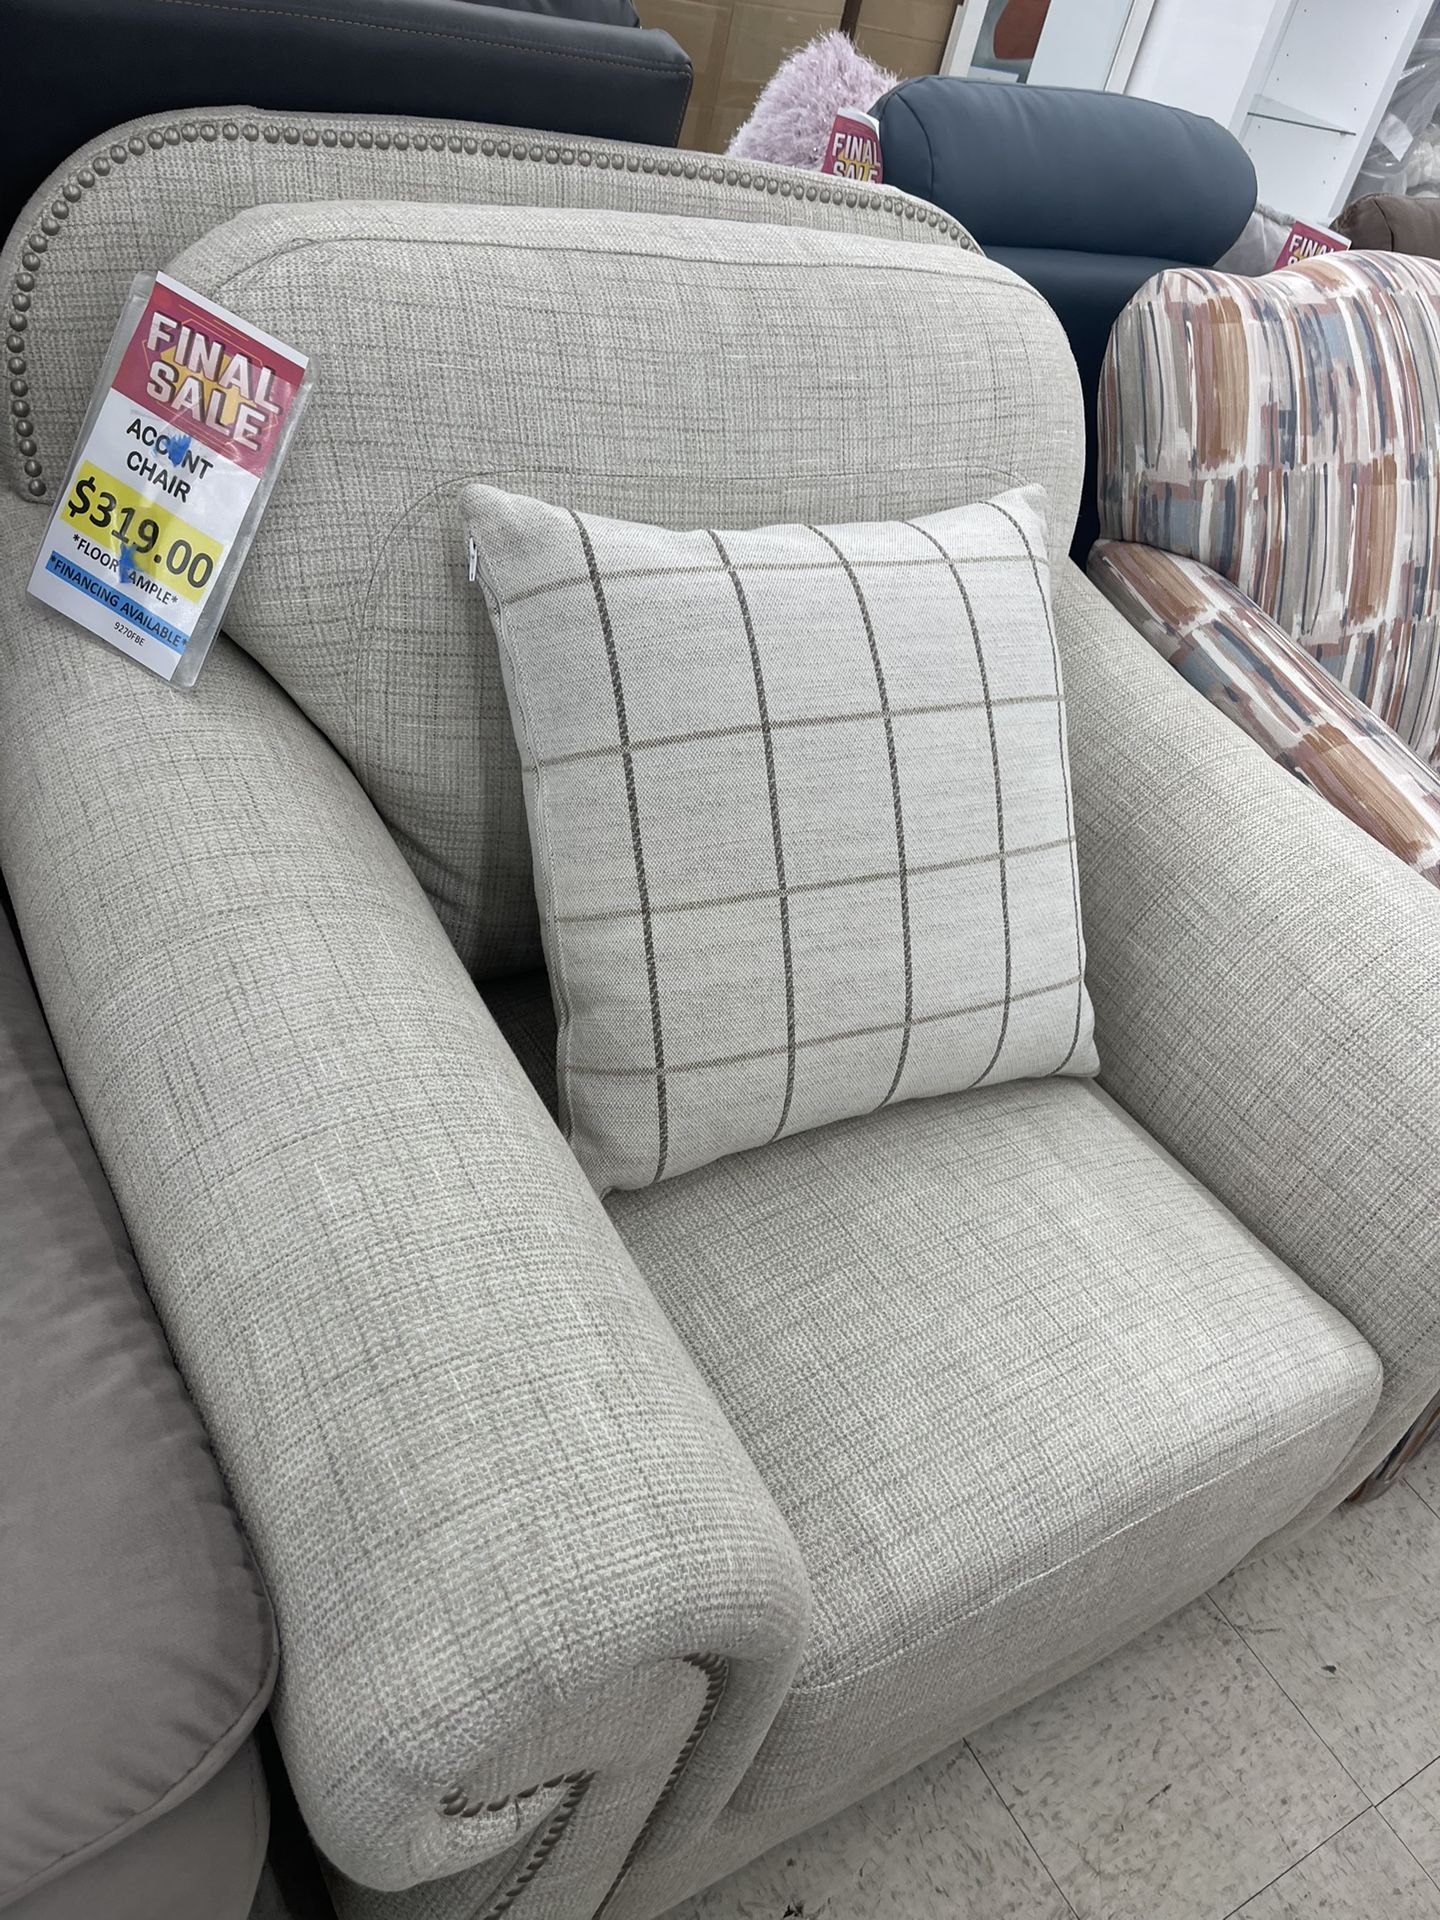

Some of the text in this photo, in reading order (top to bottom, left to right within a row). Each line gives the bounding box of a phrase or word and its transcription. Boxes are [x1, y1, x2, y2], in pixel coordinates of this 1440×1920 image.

[832, 132, 881, 167] FINAL
[1288, 234, 1335, 258] FINA
[147, 311, 281, 415] FINAL
[146, 360, 268, 452] SALE
[126, 418, 214, 479] ACCNT
[126, 450, 191, 503] CHAIR
[68, 476, 214, 588] $319.00
[120, 565, 178, 605] AMPLE
[114, 621, 145, 647] 9270FBE
